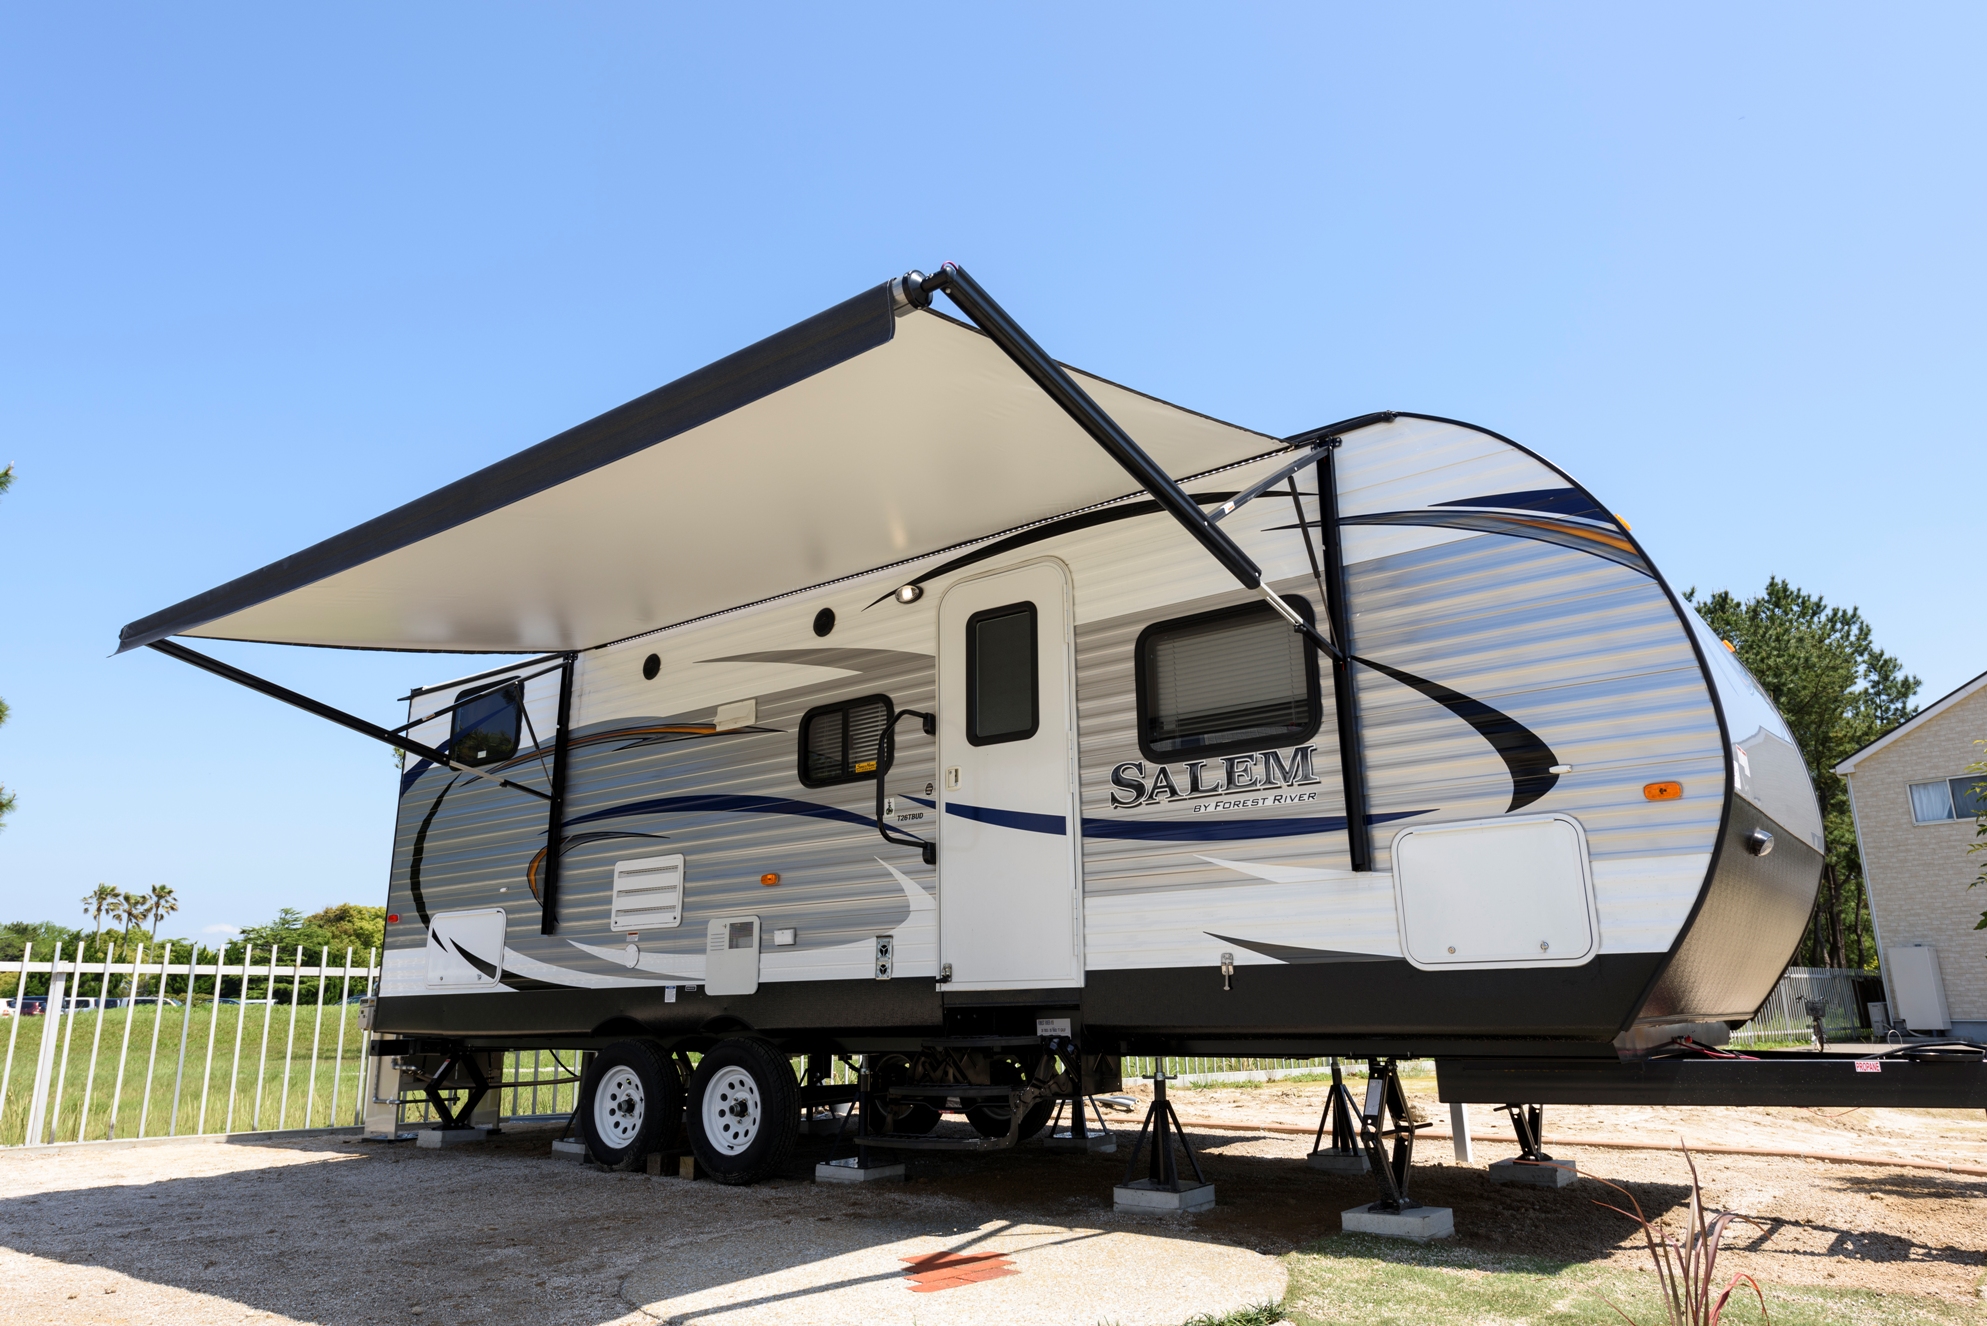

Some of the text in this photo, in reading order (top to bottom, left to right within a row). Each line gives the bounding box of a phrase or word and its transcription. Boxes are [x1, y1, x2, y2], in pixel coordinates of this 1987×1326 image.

[1110, 744, 1320, 809] SALEM
[1193, 792, 1317, 813] BY FOREST RIVER
[1856, 1062, 1879, 1071] PROPANE
